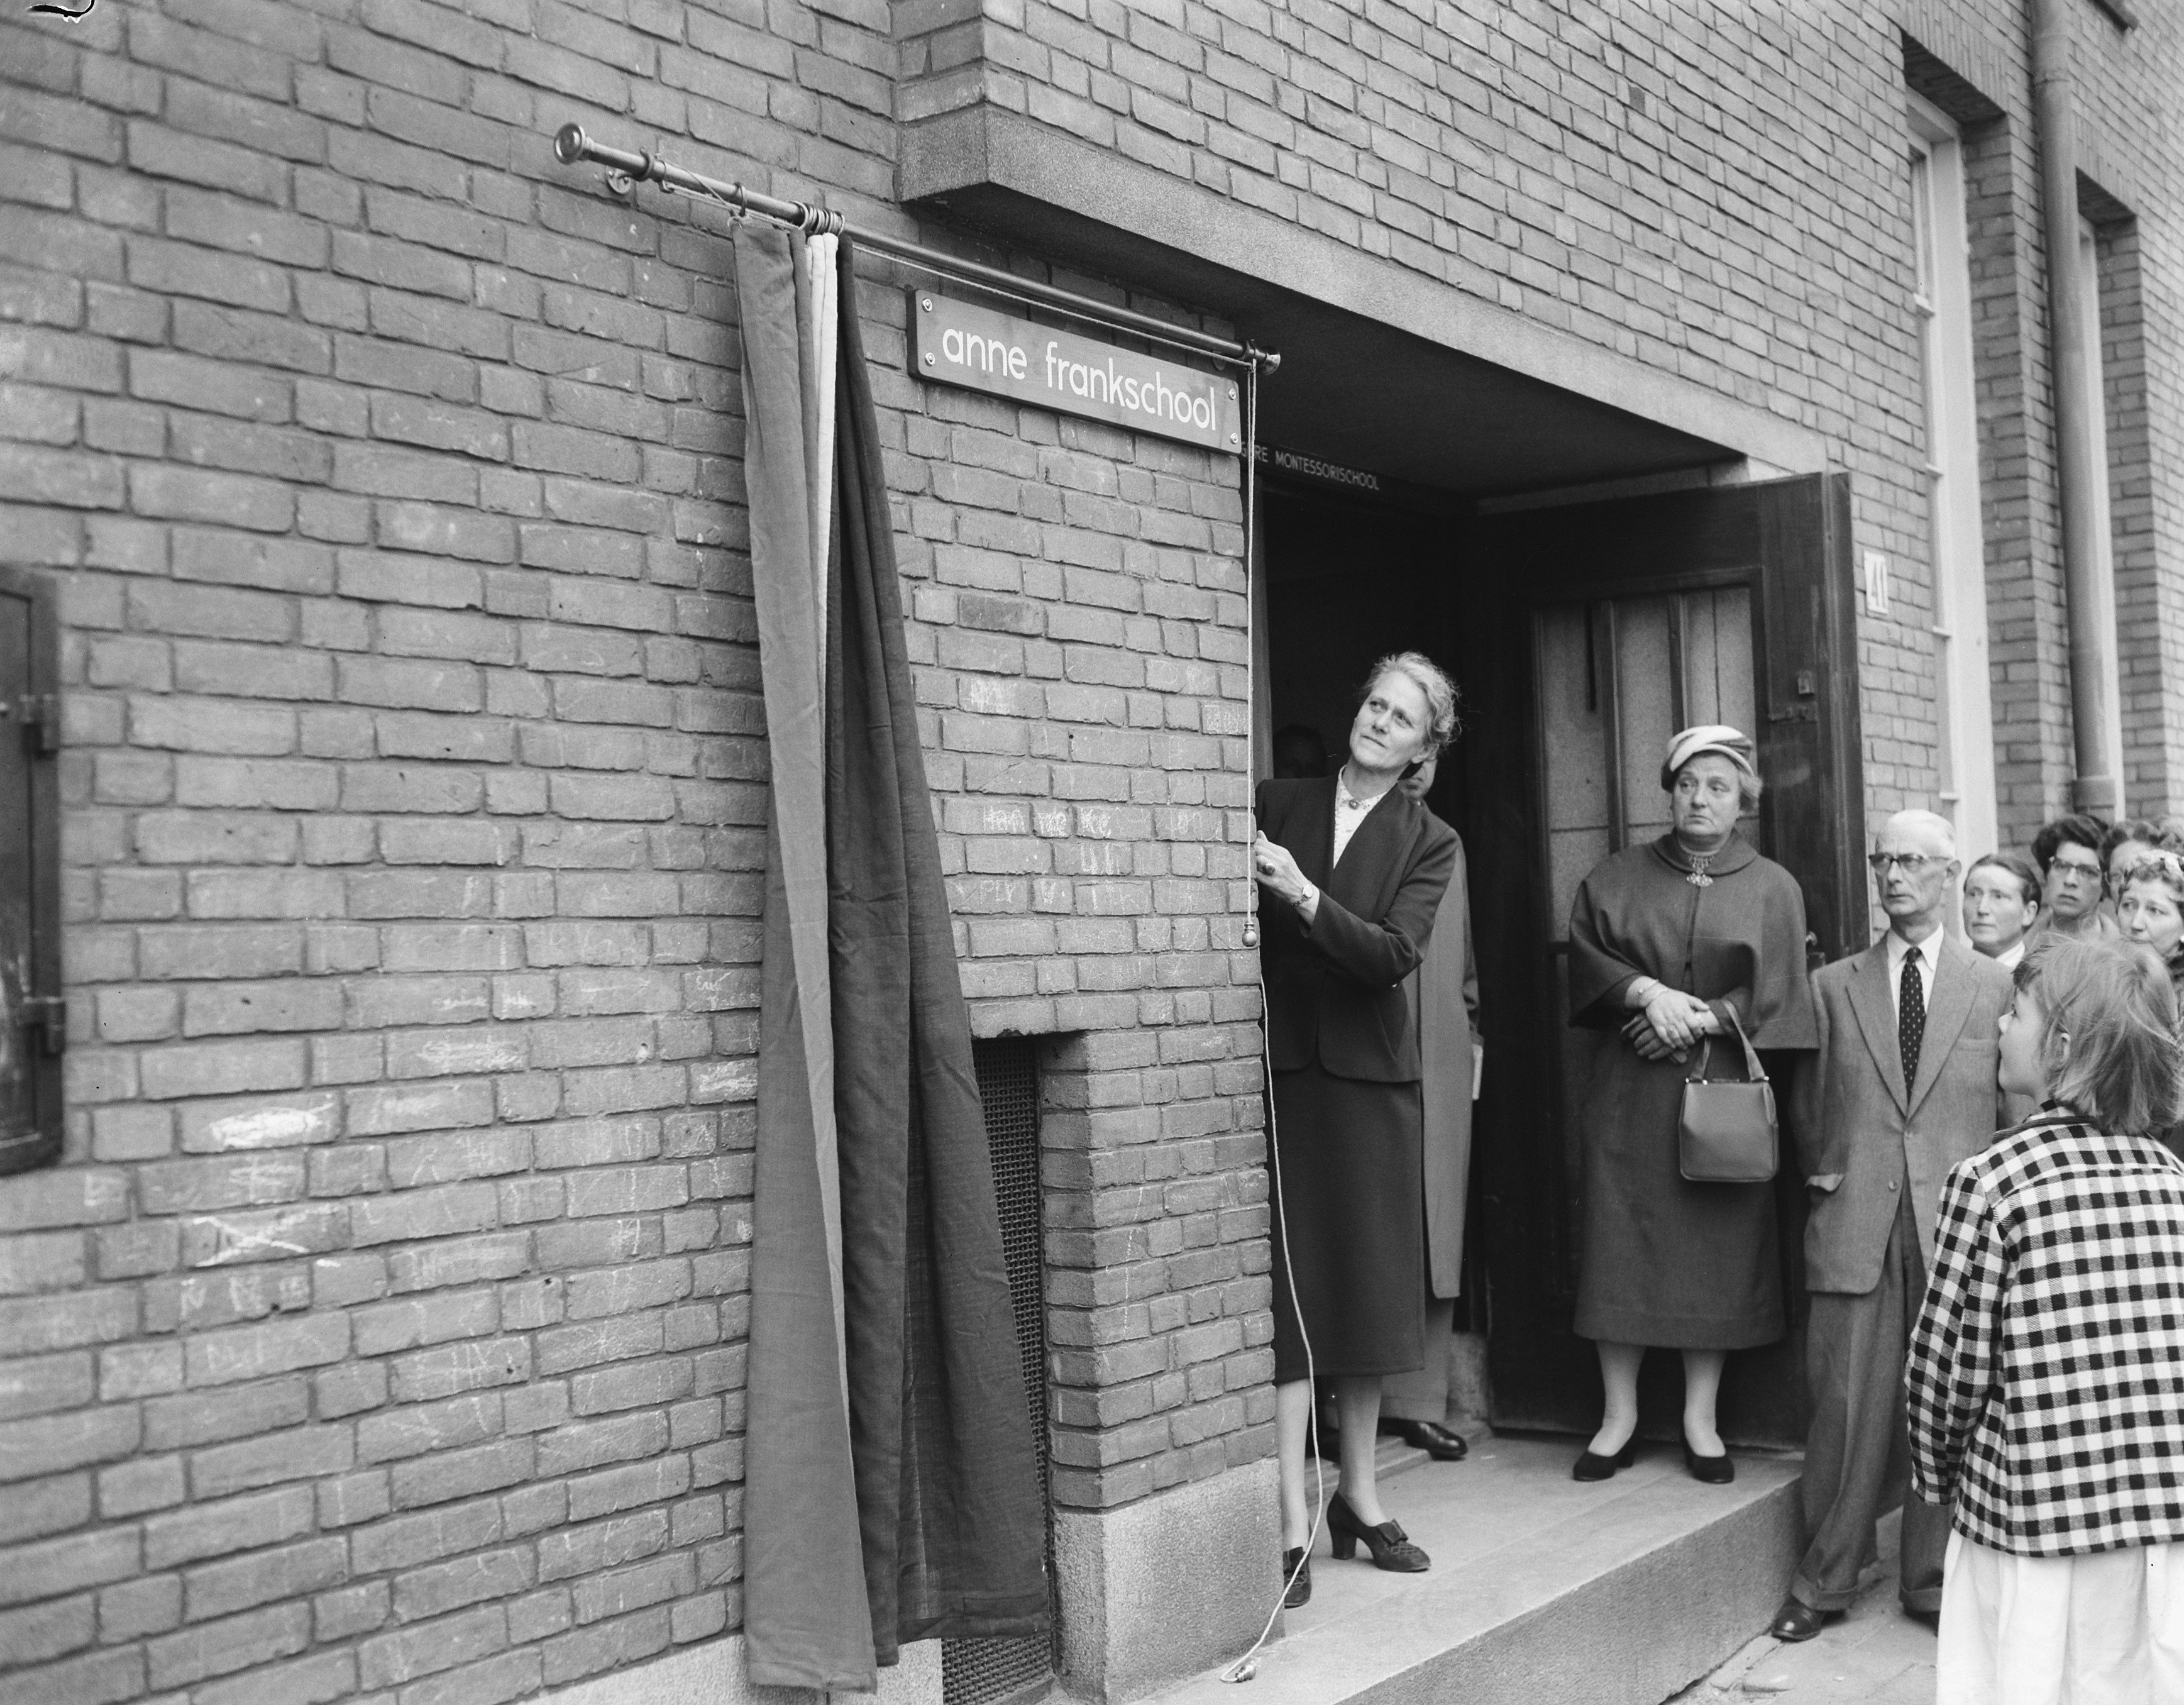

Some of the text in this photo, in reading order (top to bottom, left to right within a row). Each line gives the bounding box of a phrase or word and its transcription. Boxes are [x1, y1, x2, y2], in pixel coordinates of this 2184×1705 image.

[942, 329, 1216, 431] anne frankschool
[1276, 451, 1380, 490] MONTESSORISCHOOL
